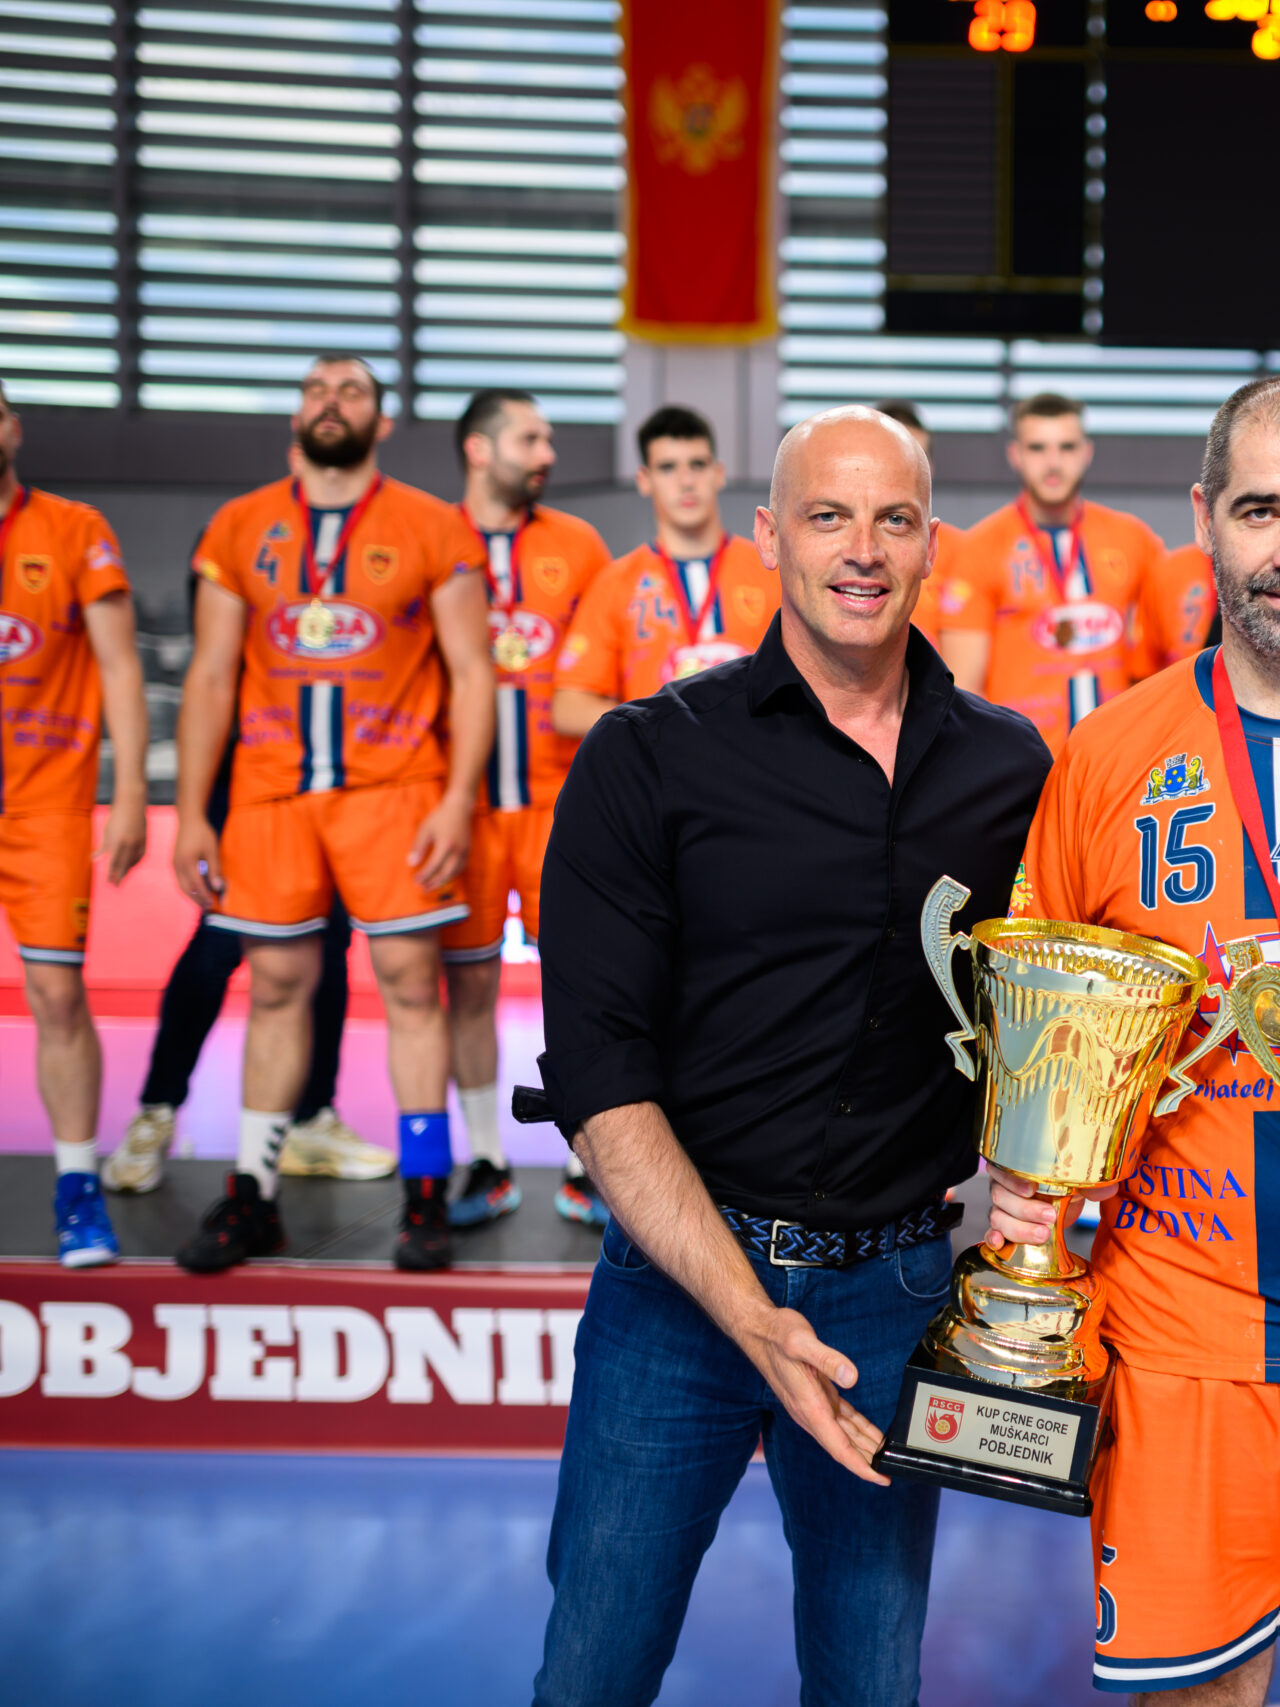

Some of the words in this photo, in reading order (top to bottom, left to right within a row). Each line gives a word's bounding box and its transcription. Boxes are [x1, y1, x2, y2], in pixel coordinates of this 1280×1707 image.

[256, 545, 279, 584] 4
[1134, 803, 1216, 910] 15
[1194, 1078, 1275, 1101] rijatelj
[1113, 1200, 1235, 1242] BUDVA
[932, 1399, 962, 1412] RSCG
[976, 1405, 1000, 1419] KUP
[1002, 1411, 1034, 1427] CRNE
[1036, 1418, 1069, 1435] GORE
[990, 1424, 1049, 1446] MUŠKARCI
[979, 1438, 1054, 1465] POBJEDNIK
